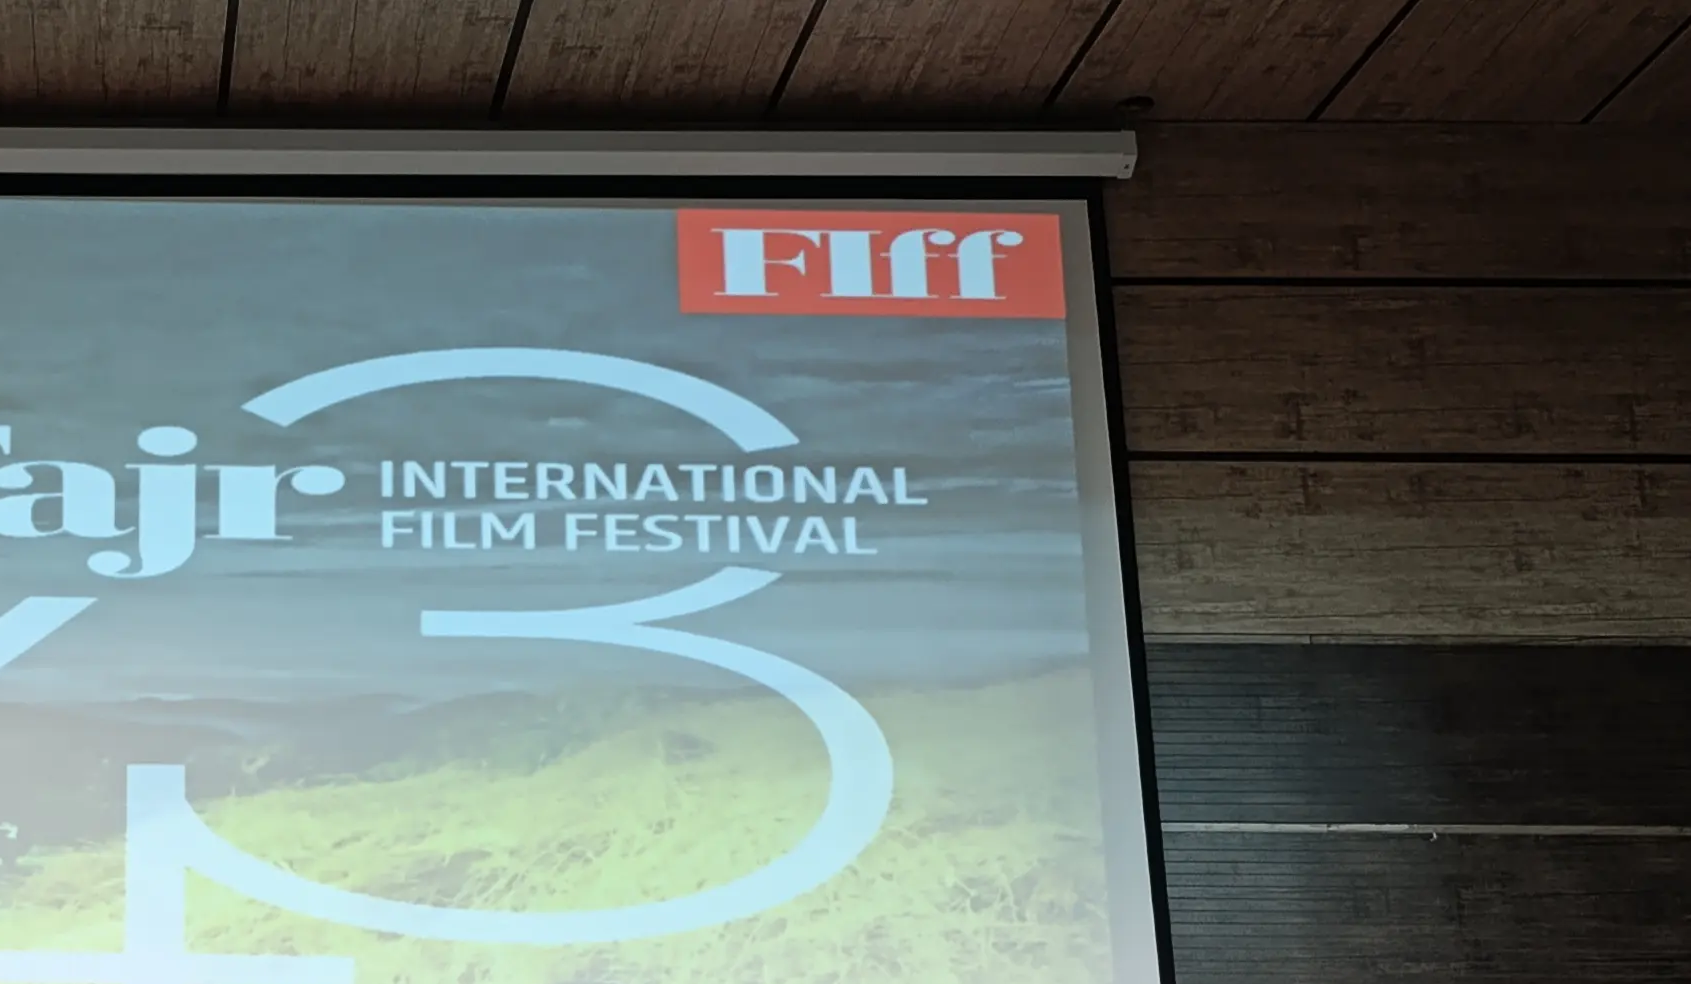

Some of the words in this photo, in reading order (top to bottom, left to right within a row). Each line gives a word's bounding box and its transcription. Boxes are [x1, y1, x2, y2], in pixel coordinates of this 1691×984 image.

[711, 228, 1024, 300] FIff
[379, 460, 929, 506] INTERNATIONAL
[380, 510, 537, 551] FILM
[565, 513, 879, 556] FESTIVAL
